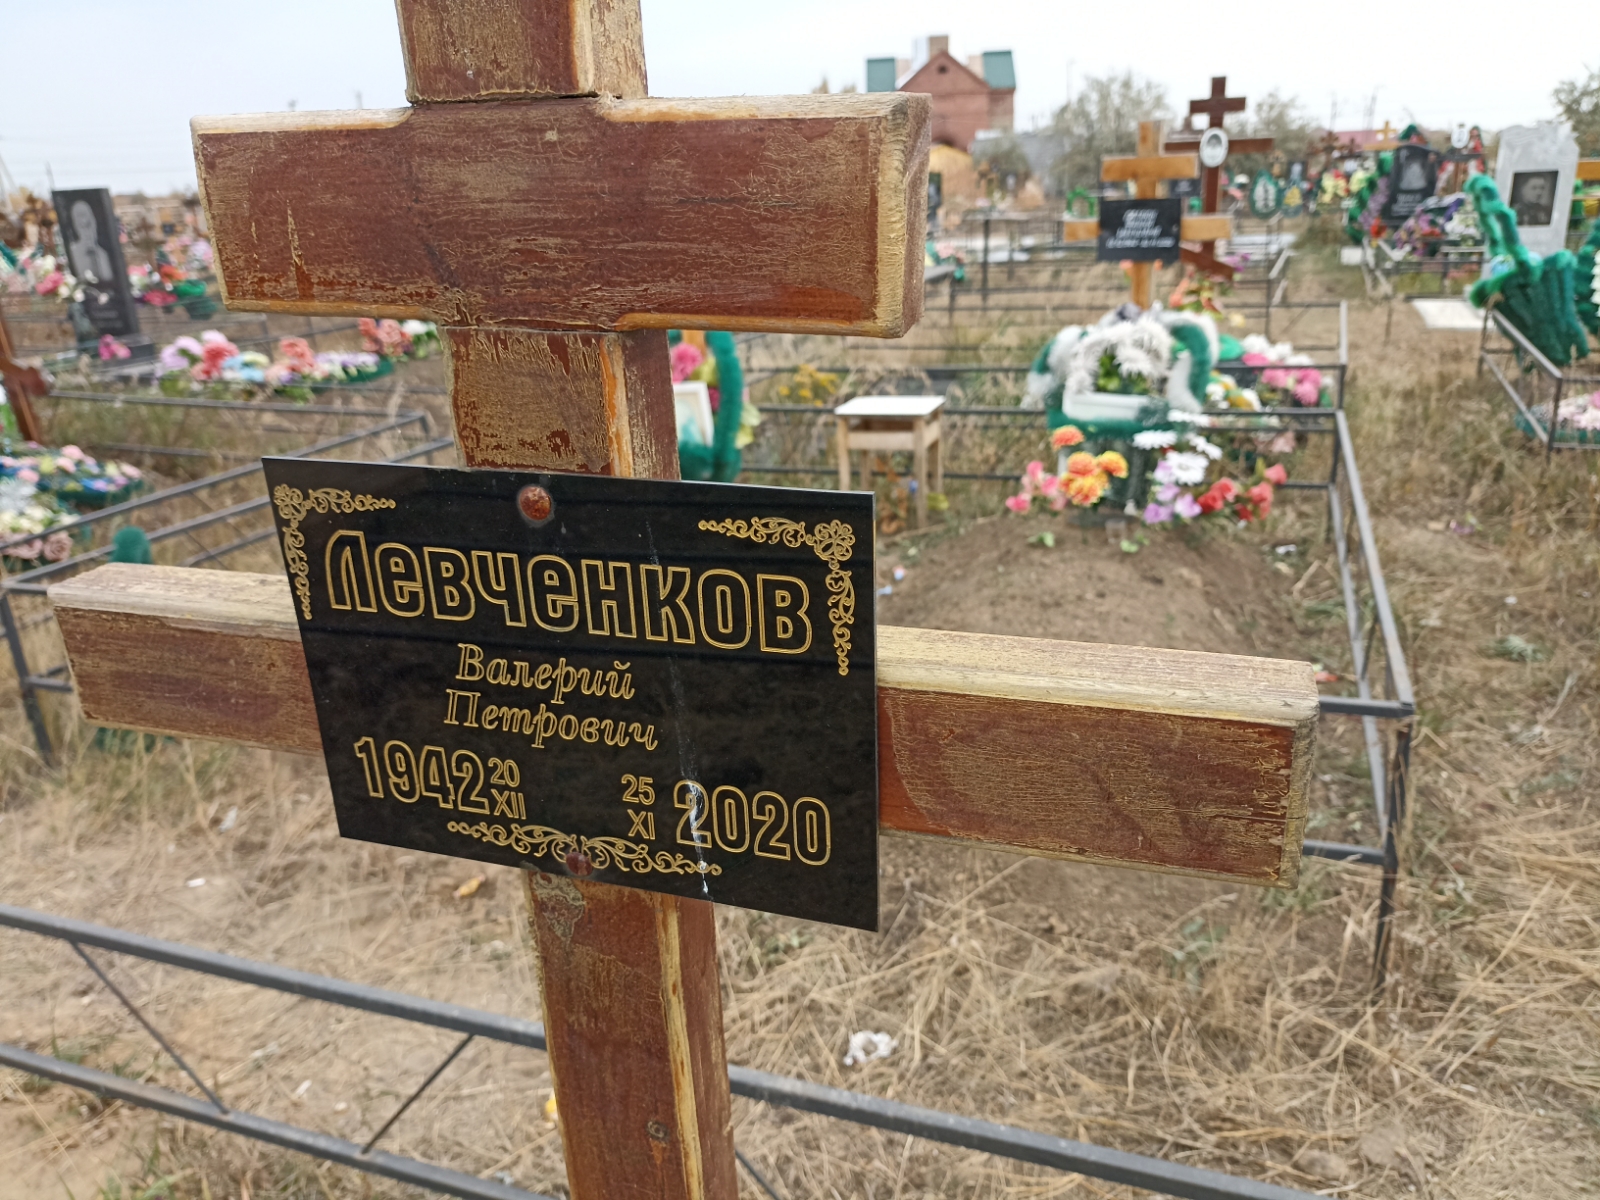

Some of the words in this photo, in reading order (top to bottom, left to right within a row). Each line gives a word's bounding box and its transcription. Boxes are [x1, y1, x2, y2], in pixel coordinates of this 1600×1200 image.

[456, 643, 636, 704] Валерий
[443, 689, 658, 751] Петрович
[354, 737, 490, 814] 1942
[488, 757, 520, 788] 20
[492, 789, 527, 820] XII
[621, 774, 655, 806] 25
[673, 780, 832, 866] 2020
[627, 809, 656, 840] XI
